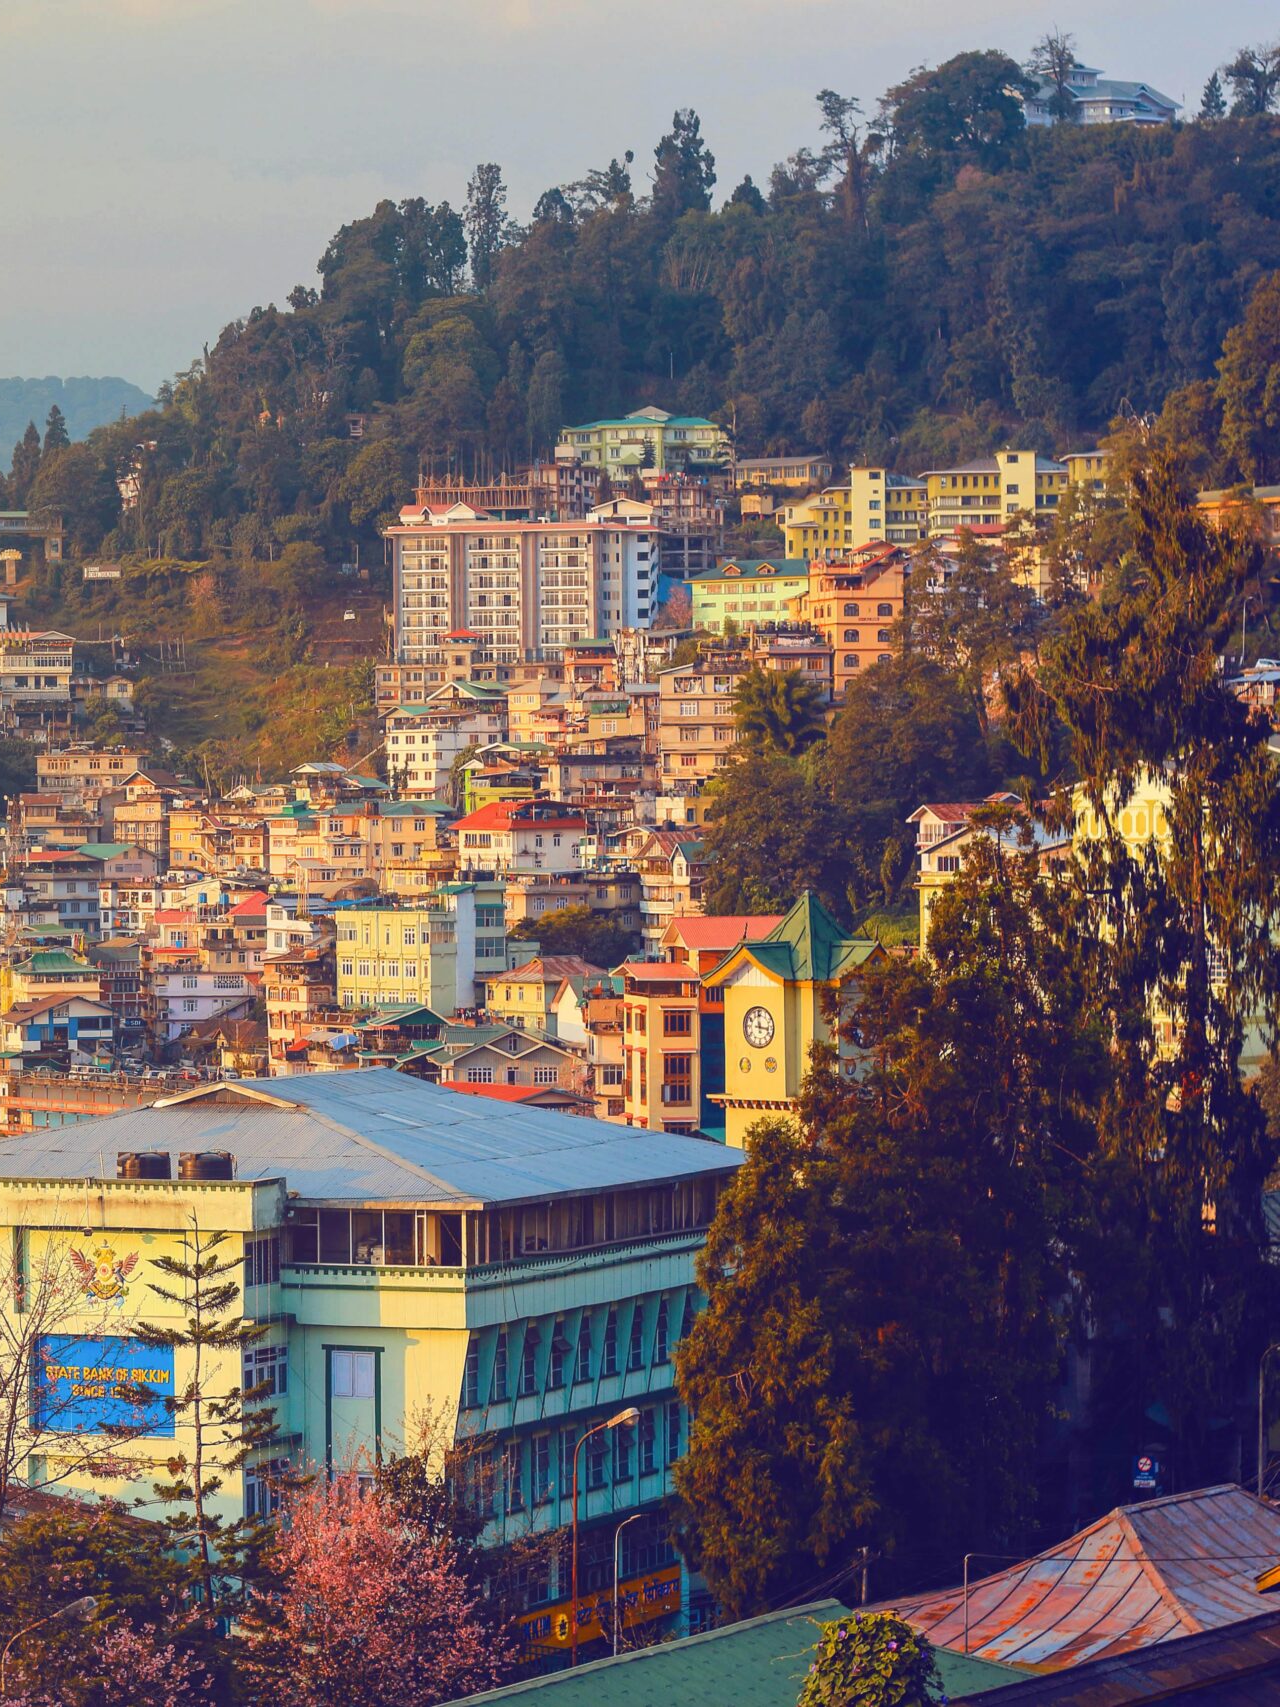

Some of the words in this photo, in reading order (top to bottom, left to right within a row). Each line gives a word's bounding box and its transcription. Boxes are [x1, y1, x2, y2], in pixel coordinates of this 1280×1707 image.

[46, 1366, 80, 1380] STATE
[83, 1367, 114, 1381] BANK
[116, 1369, 128, 1382] OF
[131, 1369, 171, 1383] SIKKIM
[72, 1384, 105, 1397] SINCE
